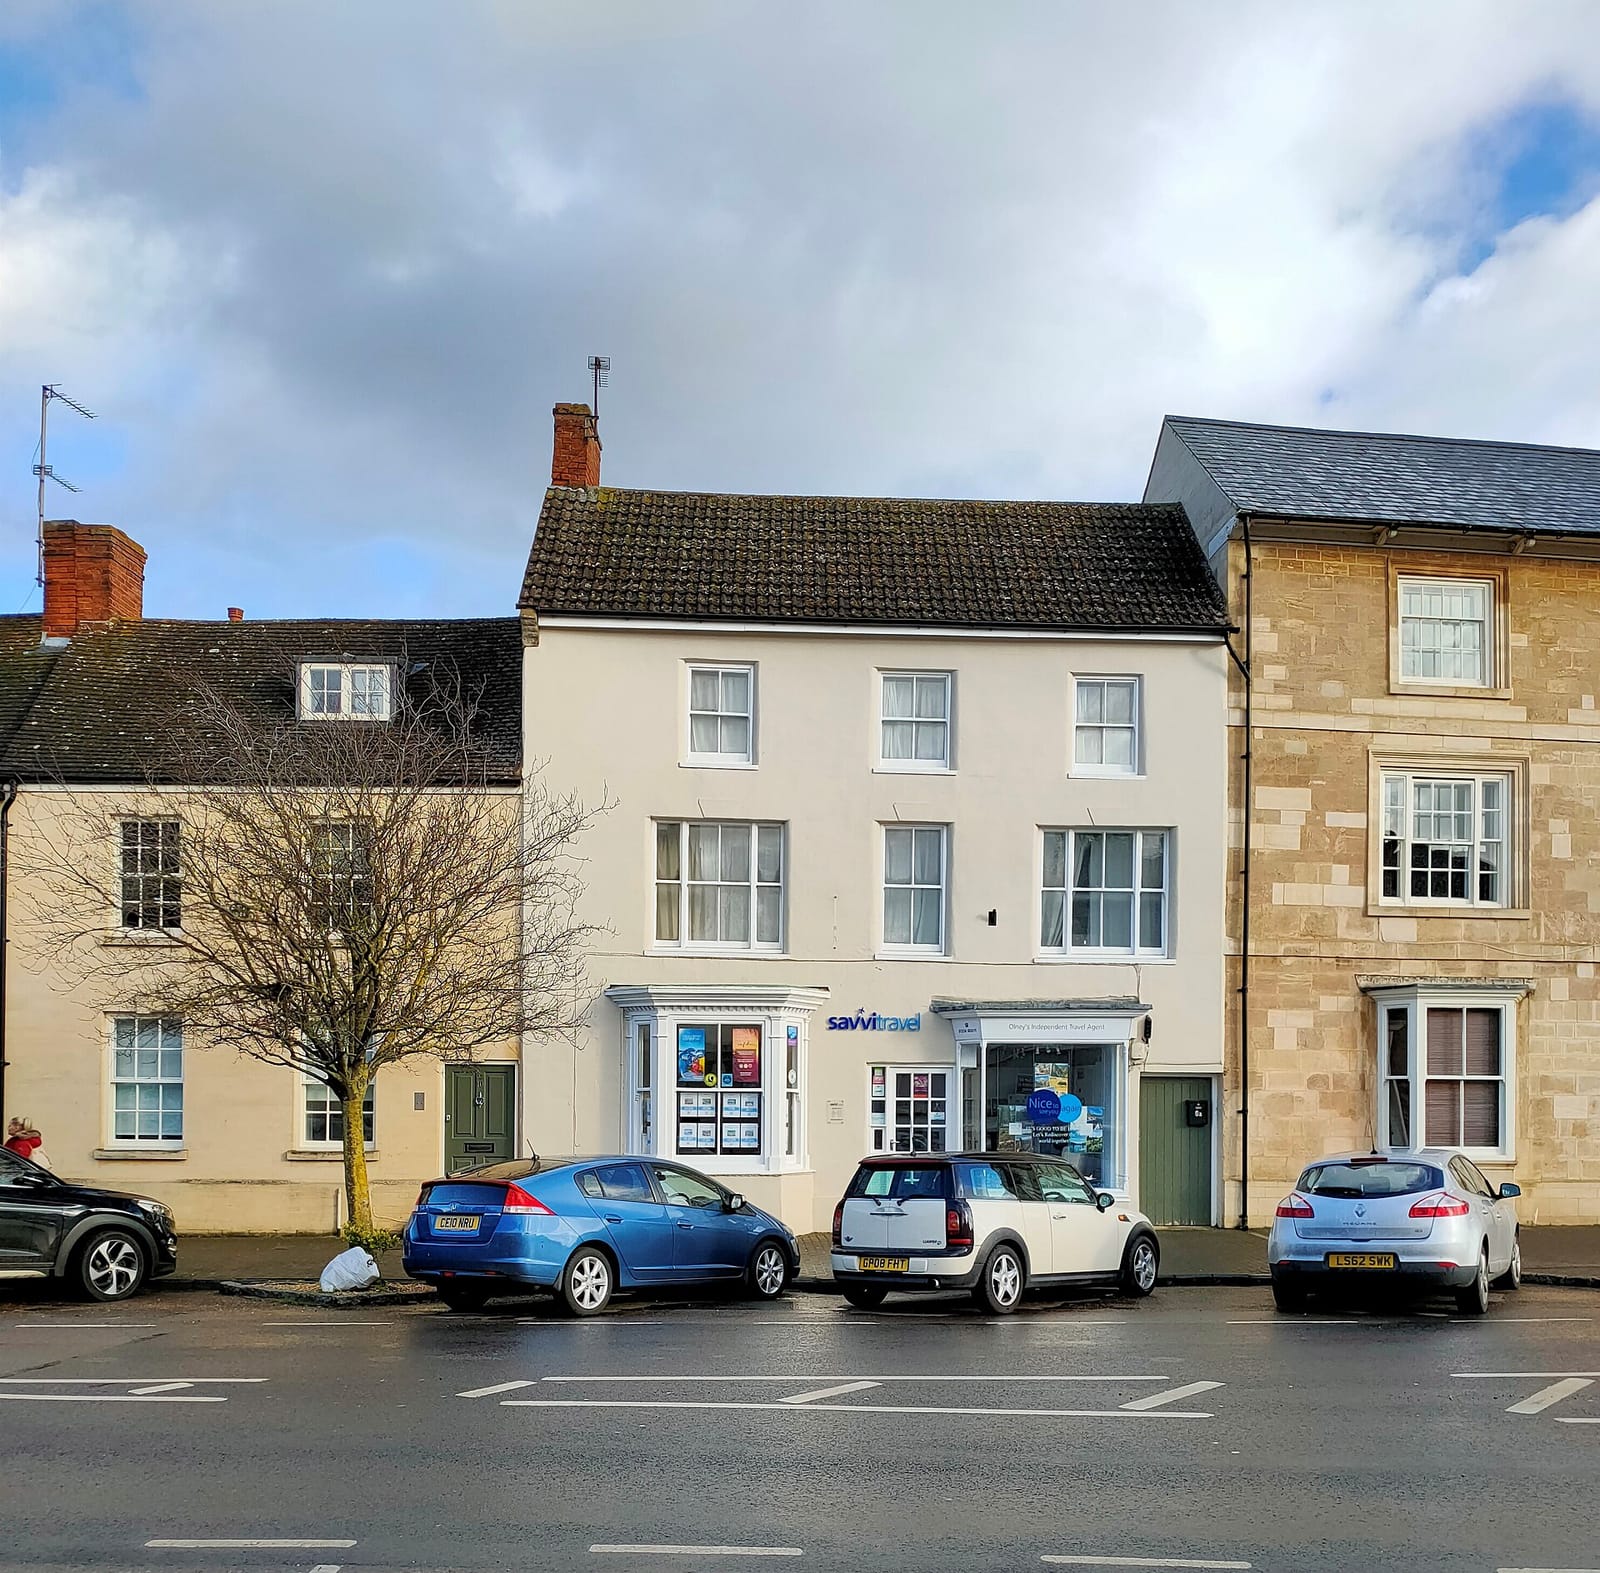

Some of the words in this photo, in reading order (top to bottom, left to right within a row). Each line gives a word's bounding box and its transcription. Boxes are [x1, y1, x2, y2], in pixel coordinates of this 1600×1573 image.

[1031, 1023, 1068, 1032] Independent
[1069, 1023, 1086, 1031] Travel
[1087, 1023, 1105, 1032] Agent
[1029, 1097, 1053, 1109] Nice
[887, 1258, 907, 1270] FHT
[1336, 1256, 1366, 1266] LS62
[1369, 1256, 1392, 1267] SWK
